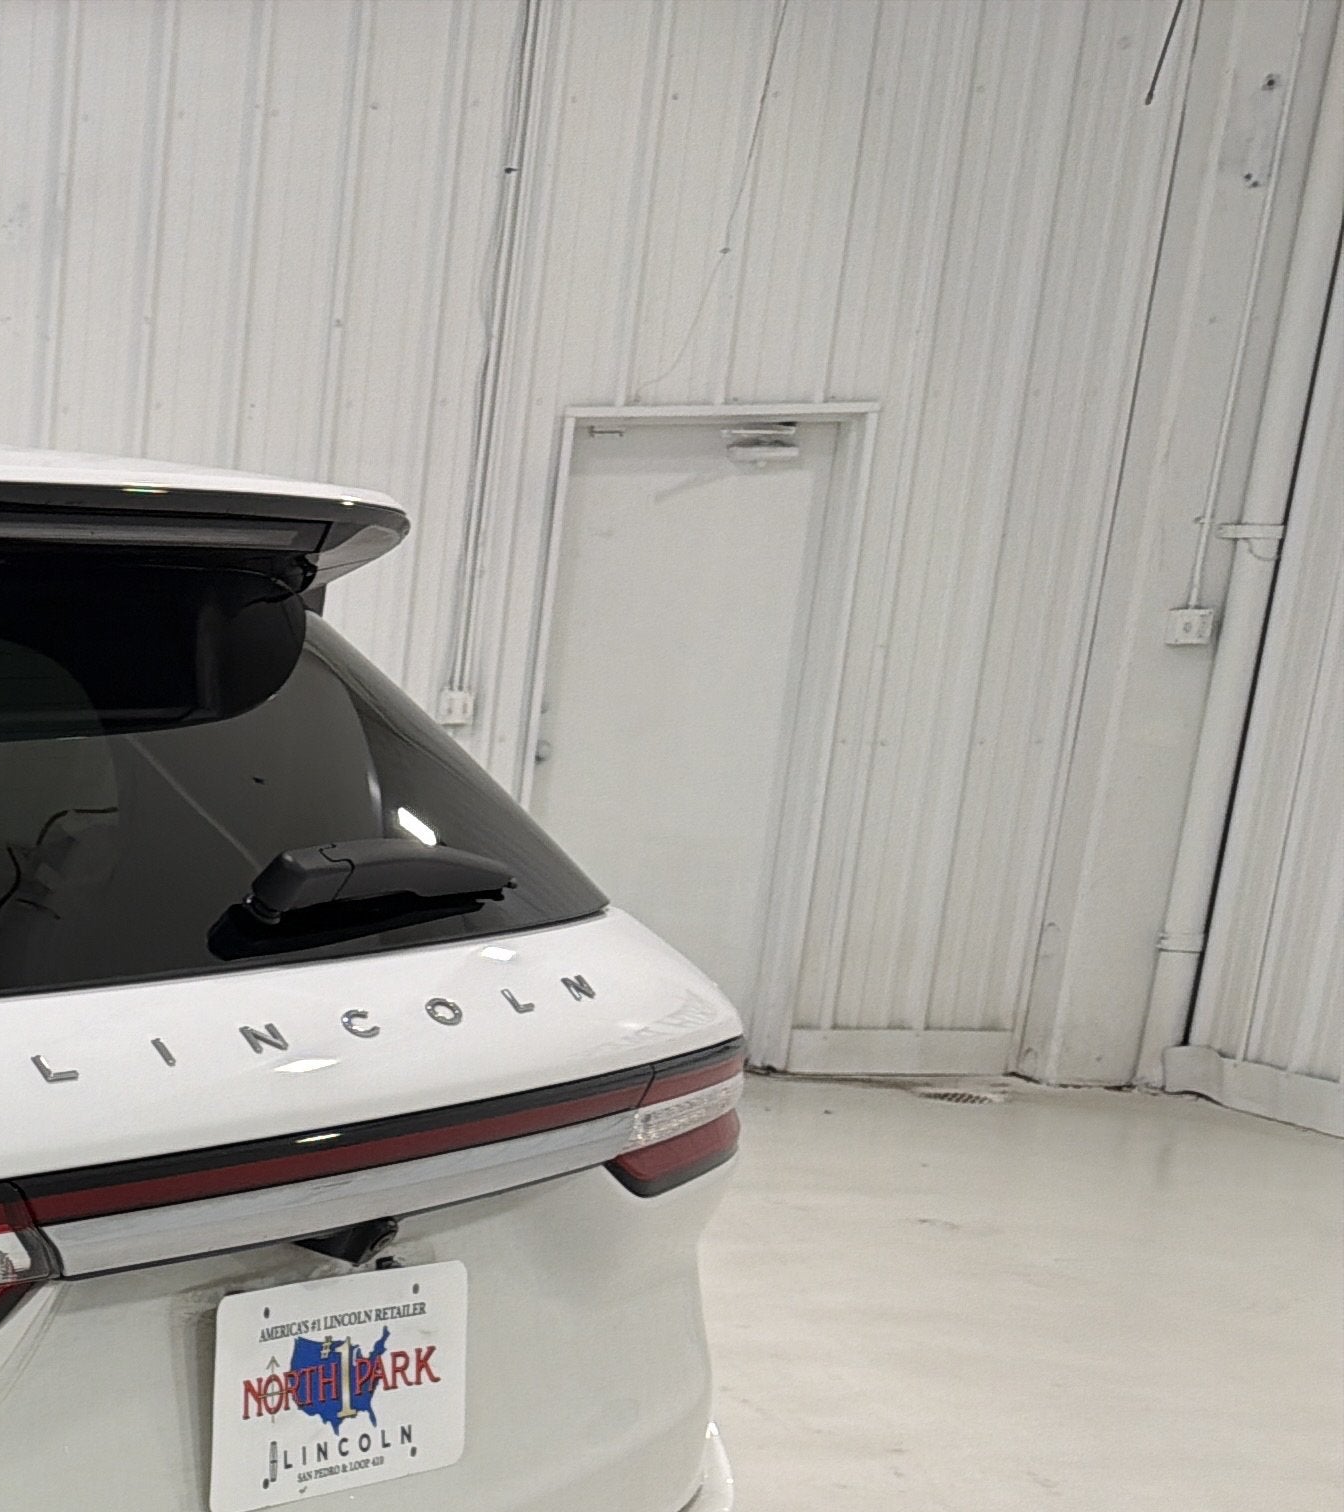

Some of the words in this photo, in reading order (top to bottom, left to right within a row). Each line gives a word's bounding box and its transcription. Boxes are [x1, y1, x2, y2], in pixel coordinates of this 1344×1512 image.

[30, 974, 597, 1083] LINCOLN
[259, 1319, 310, 1343] AMERICA'S
[311, 1319, 322, 1332] #1
[323, 1309, 373, 1331] LINCOLN
[374, 1301, 427, 1322] RETAILER
[243, 1363, 339, 1420] NORTH
[355, 1345, 441, 1396] PARK
[283, 1424, 413, 1470] LINCOLN
[297, 1470, 313, 1484] SAN
[313, 1464, 341, 1480] PEDRO
[348, 1458, 371, 1472] LOOP
